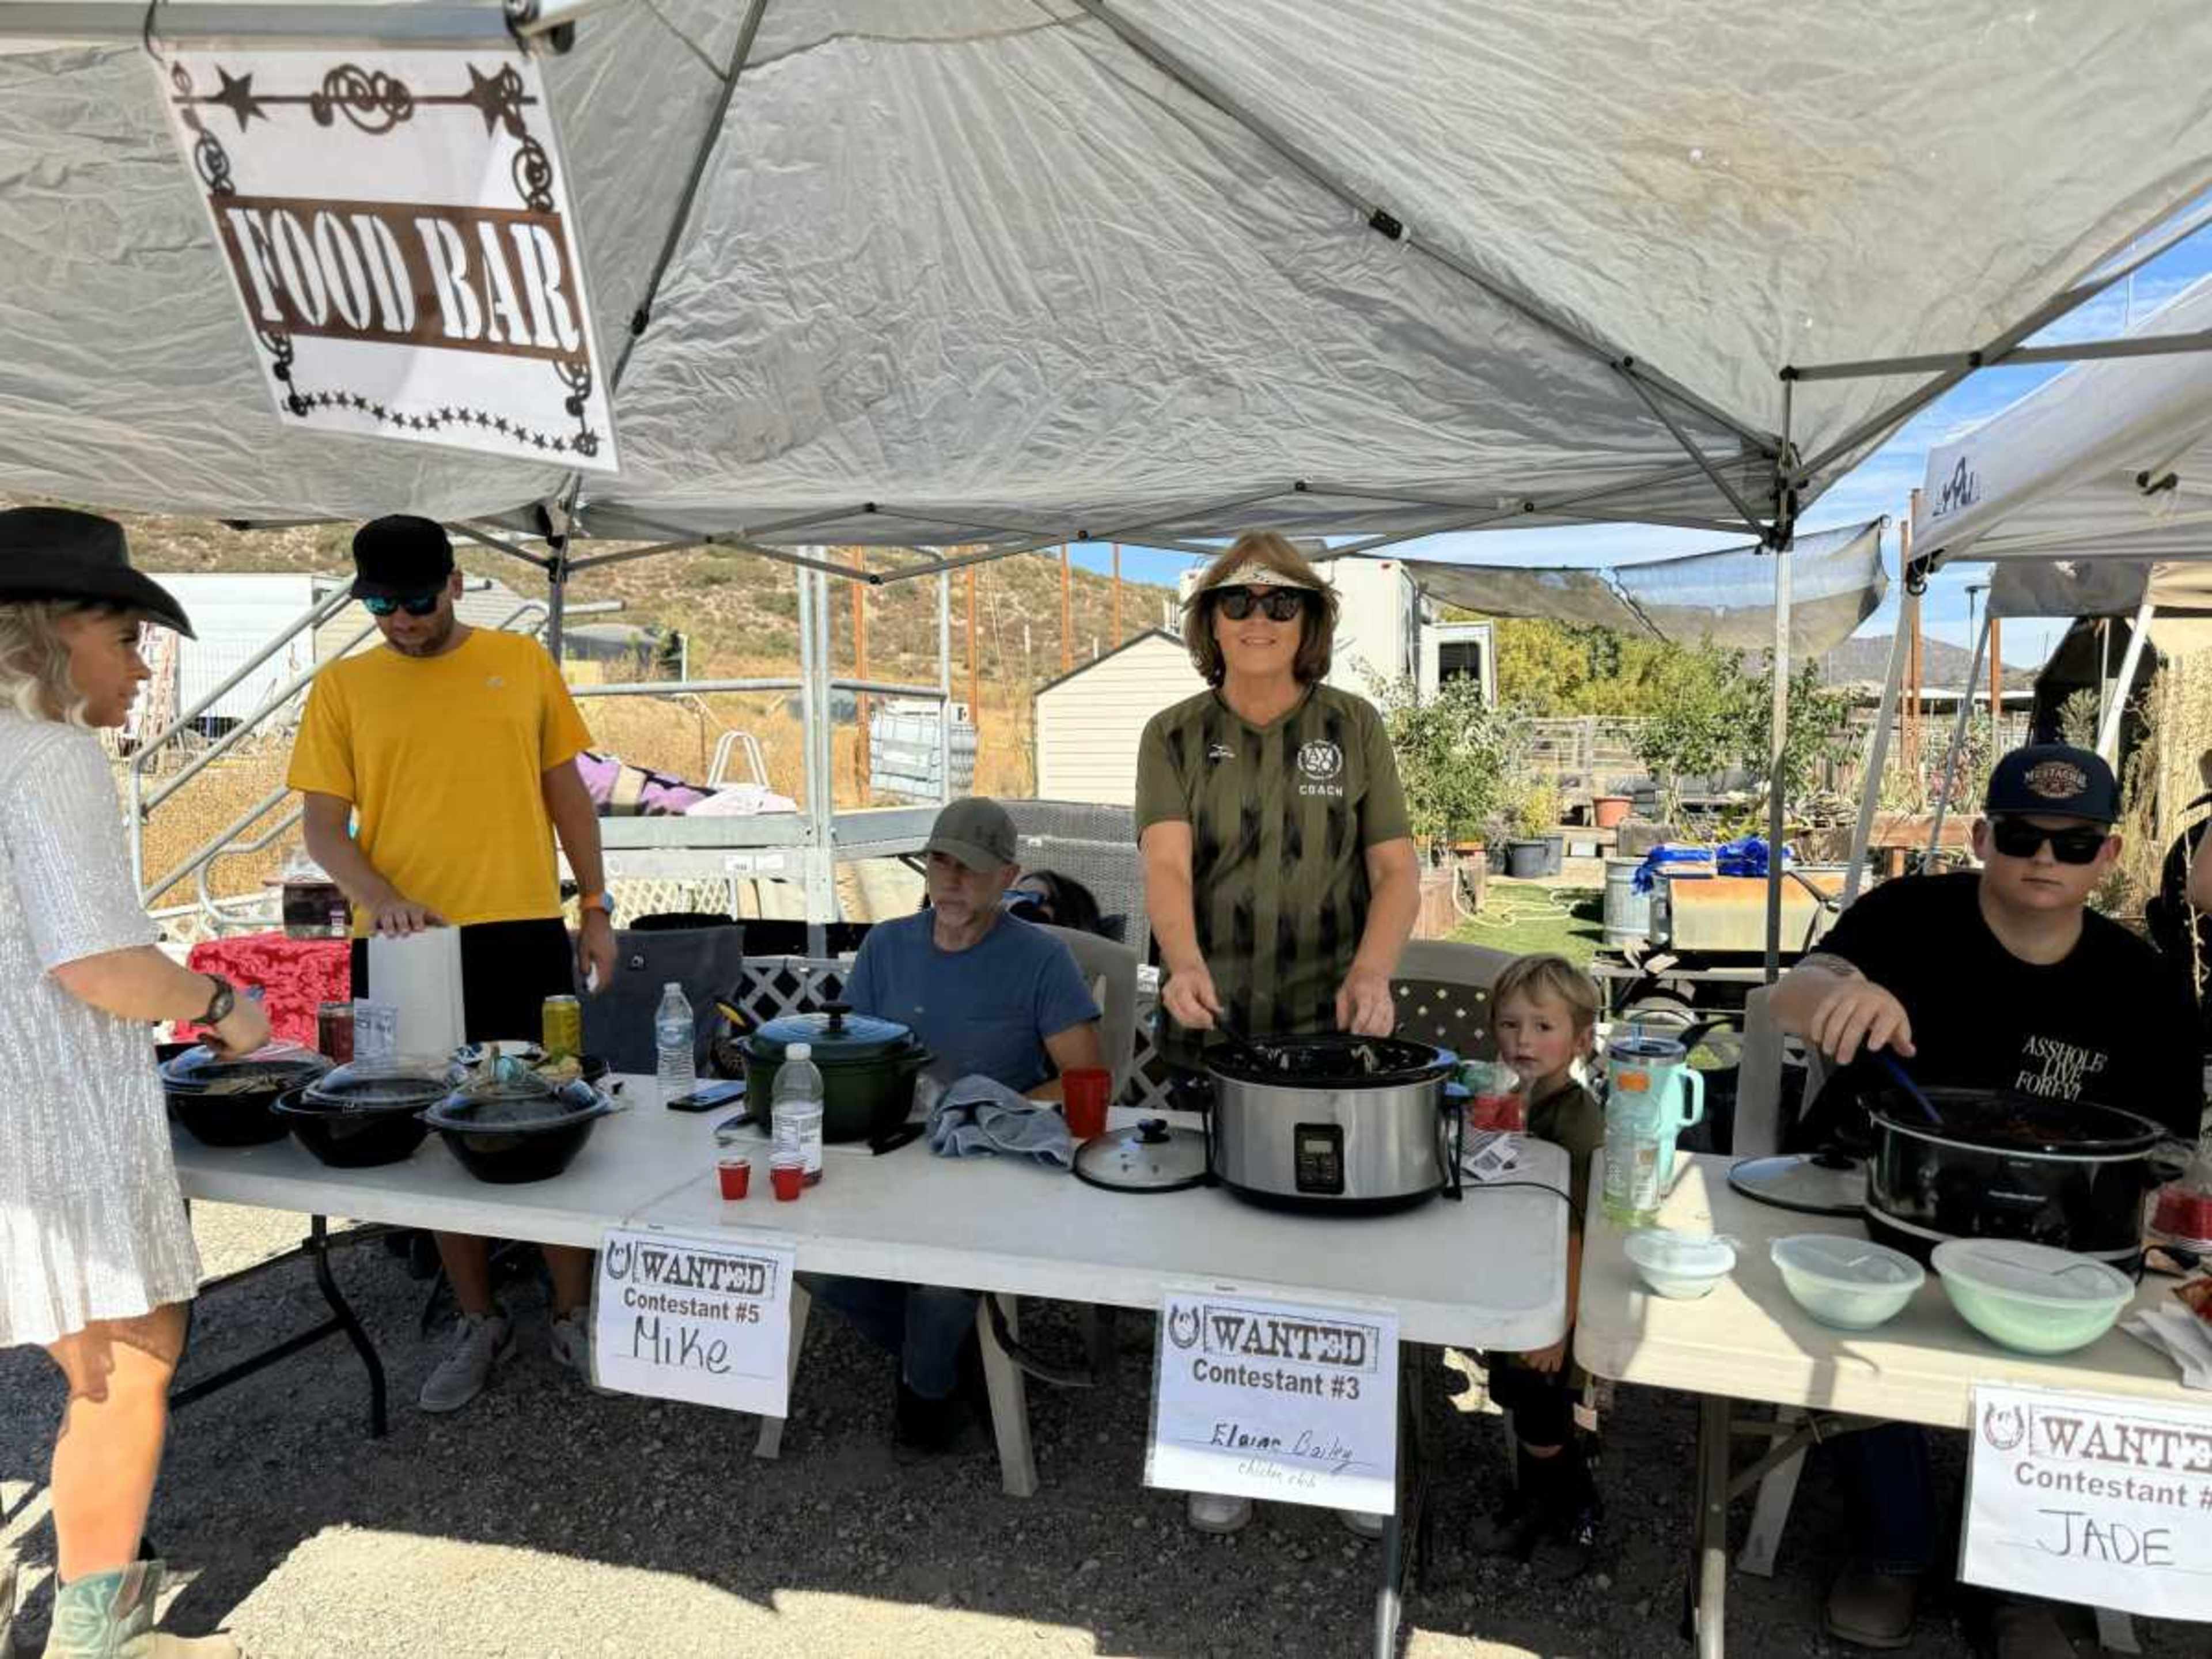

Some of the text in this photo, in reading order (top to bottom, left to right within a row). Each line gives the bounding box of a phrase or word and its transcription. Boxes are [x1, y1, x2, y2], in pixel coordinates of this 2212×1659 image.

[226, 208, 580, 353] FOOD BAR
[1299, 785, 1343, 797] COACH
[641, 1251, 766, 1295] WANTED
[624, 1288, 760, 1324] Contestant #5
[1211, 1315, 1366, 1366] WANTED
[1193, 1358, 1359, 1400] Contestant #3
[2016, 1461, 2188, 1507] Contestant
[2036, 1508, 2175, 1566] JADE
